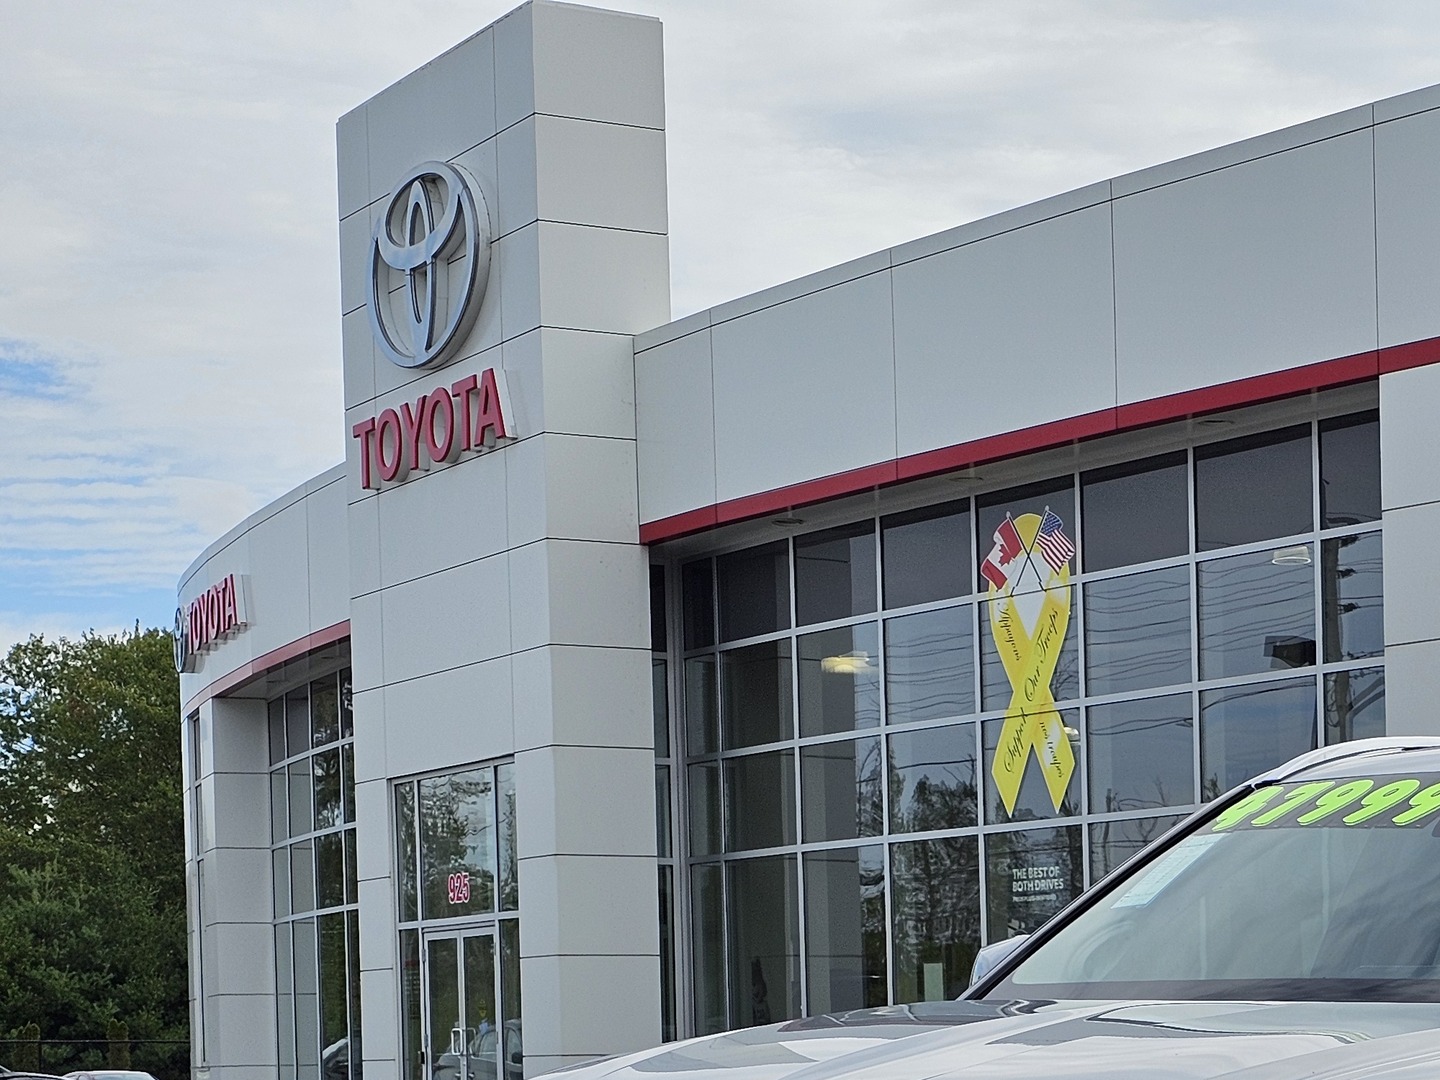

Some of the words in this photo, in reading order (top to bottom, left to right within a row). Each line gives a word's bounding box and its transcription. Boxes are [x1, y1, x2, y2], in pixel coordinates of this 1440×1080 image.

[353, 368, 508, 490] TOYOTA
[186, 573, 238, 655] TOYOTA
[448, 872, 470, 904] 925
[1012, 868, 1027, 880] THE
[1028, 867, 1048, 878] BEST
[1048, 866, 1060, 877] OF
[1012, 880, 1034, 892] BOTH
[1034, 878, 1064, 891] DRIVES
